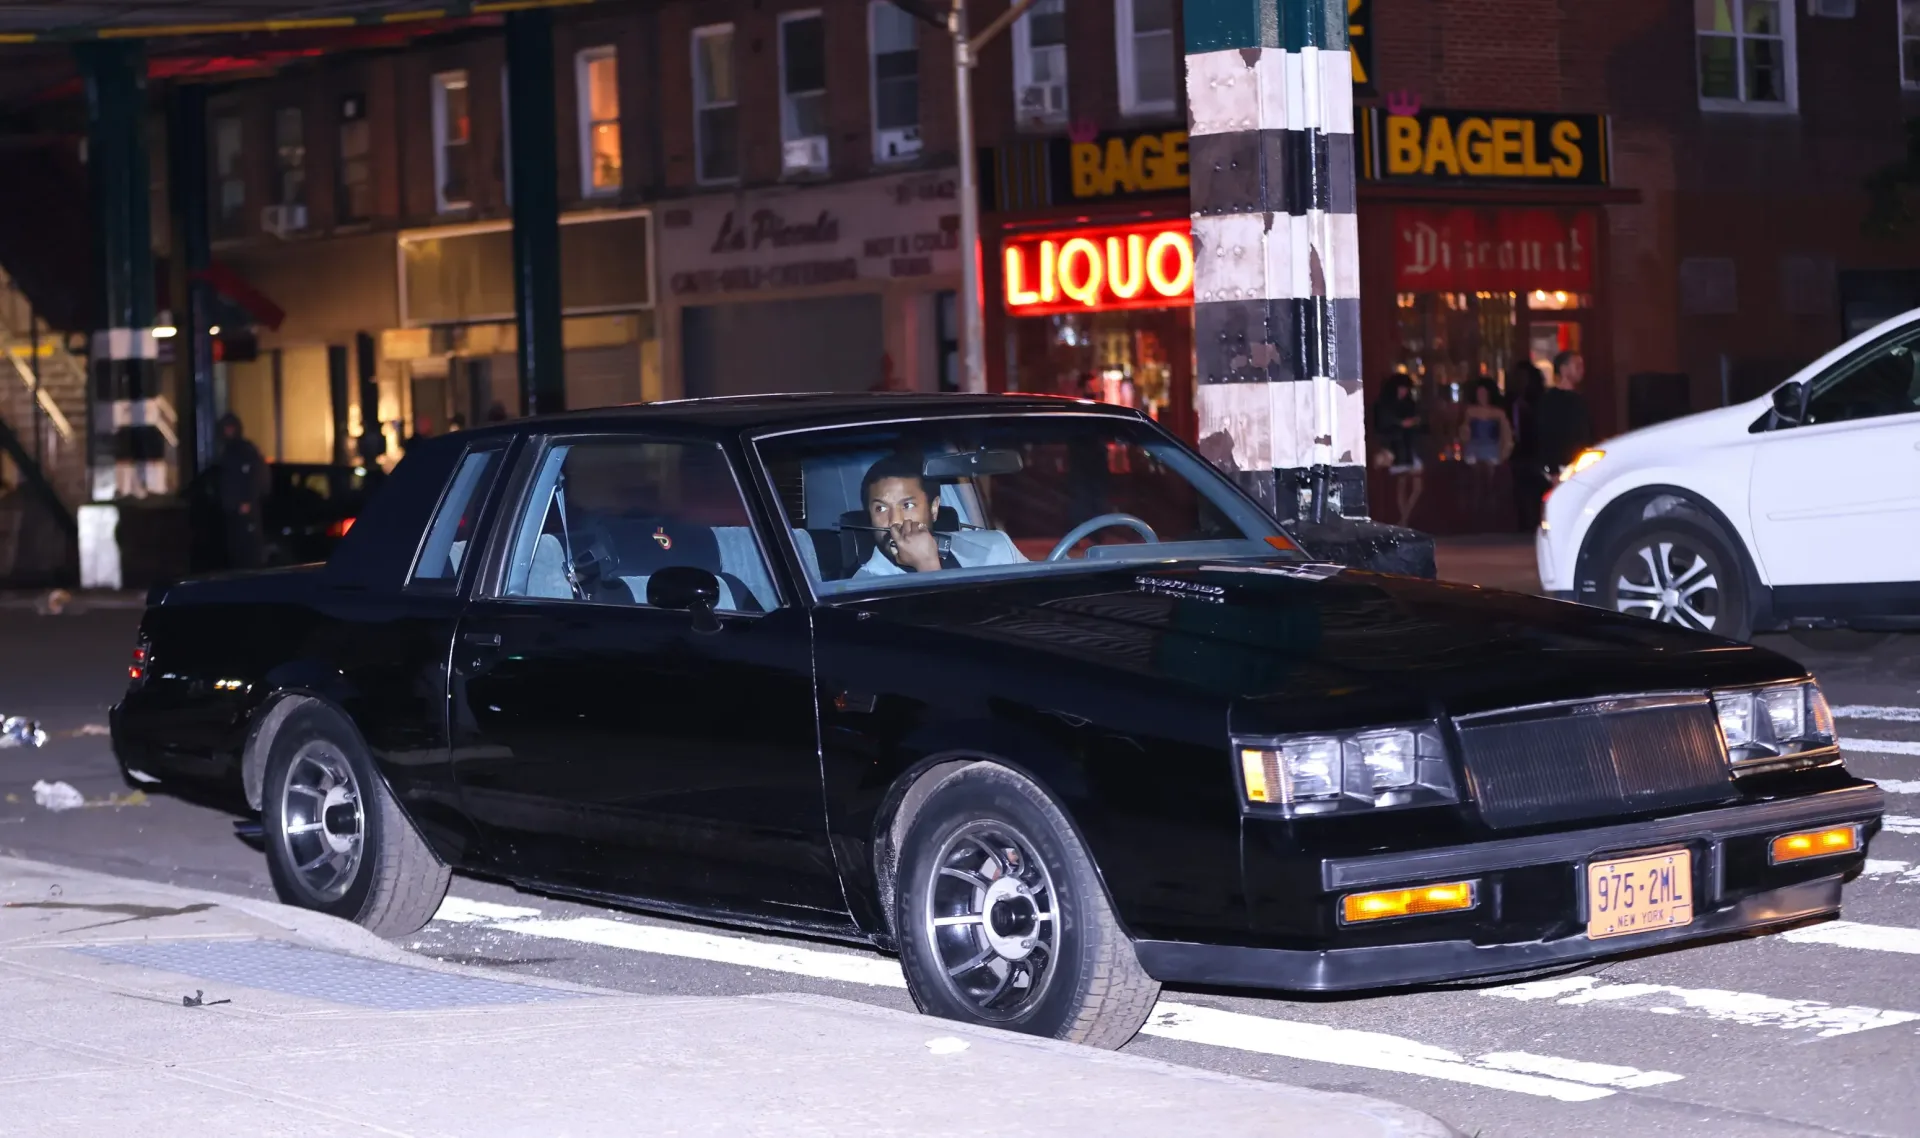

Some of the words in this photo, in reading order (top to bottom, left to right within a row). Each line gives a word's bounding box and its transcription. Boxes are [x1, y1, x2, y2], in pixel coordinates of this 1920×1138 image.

[1386, 115, 1583, 178] BAGELS
[1617, 914, 1636, 928] NEW
[1643, 909, 1664, 924] YORK
